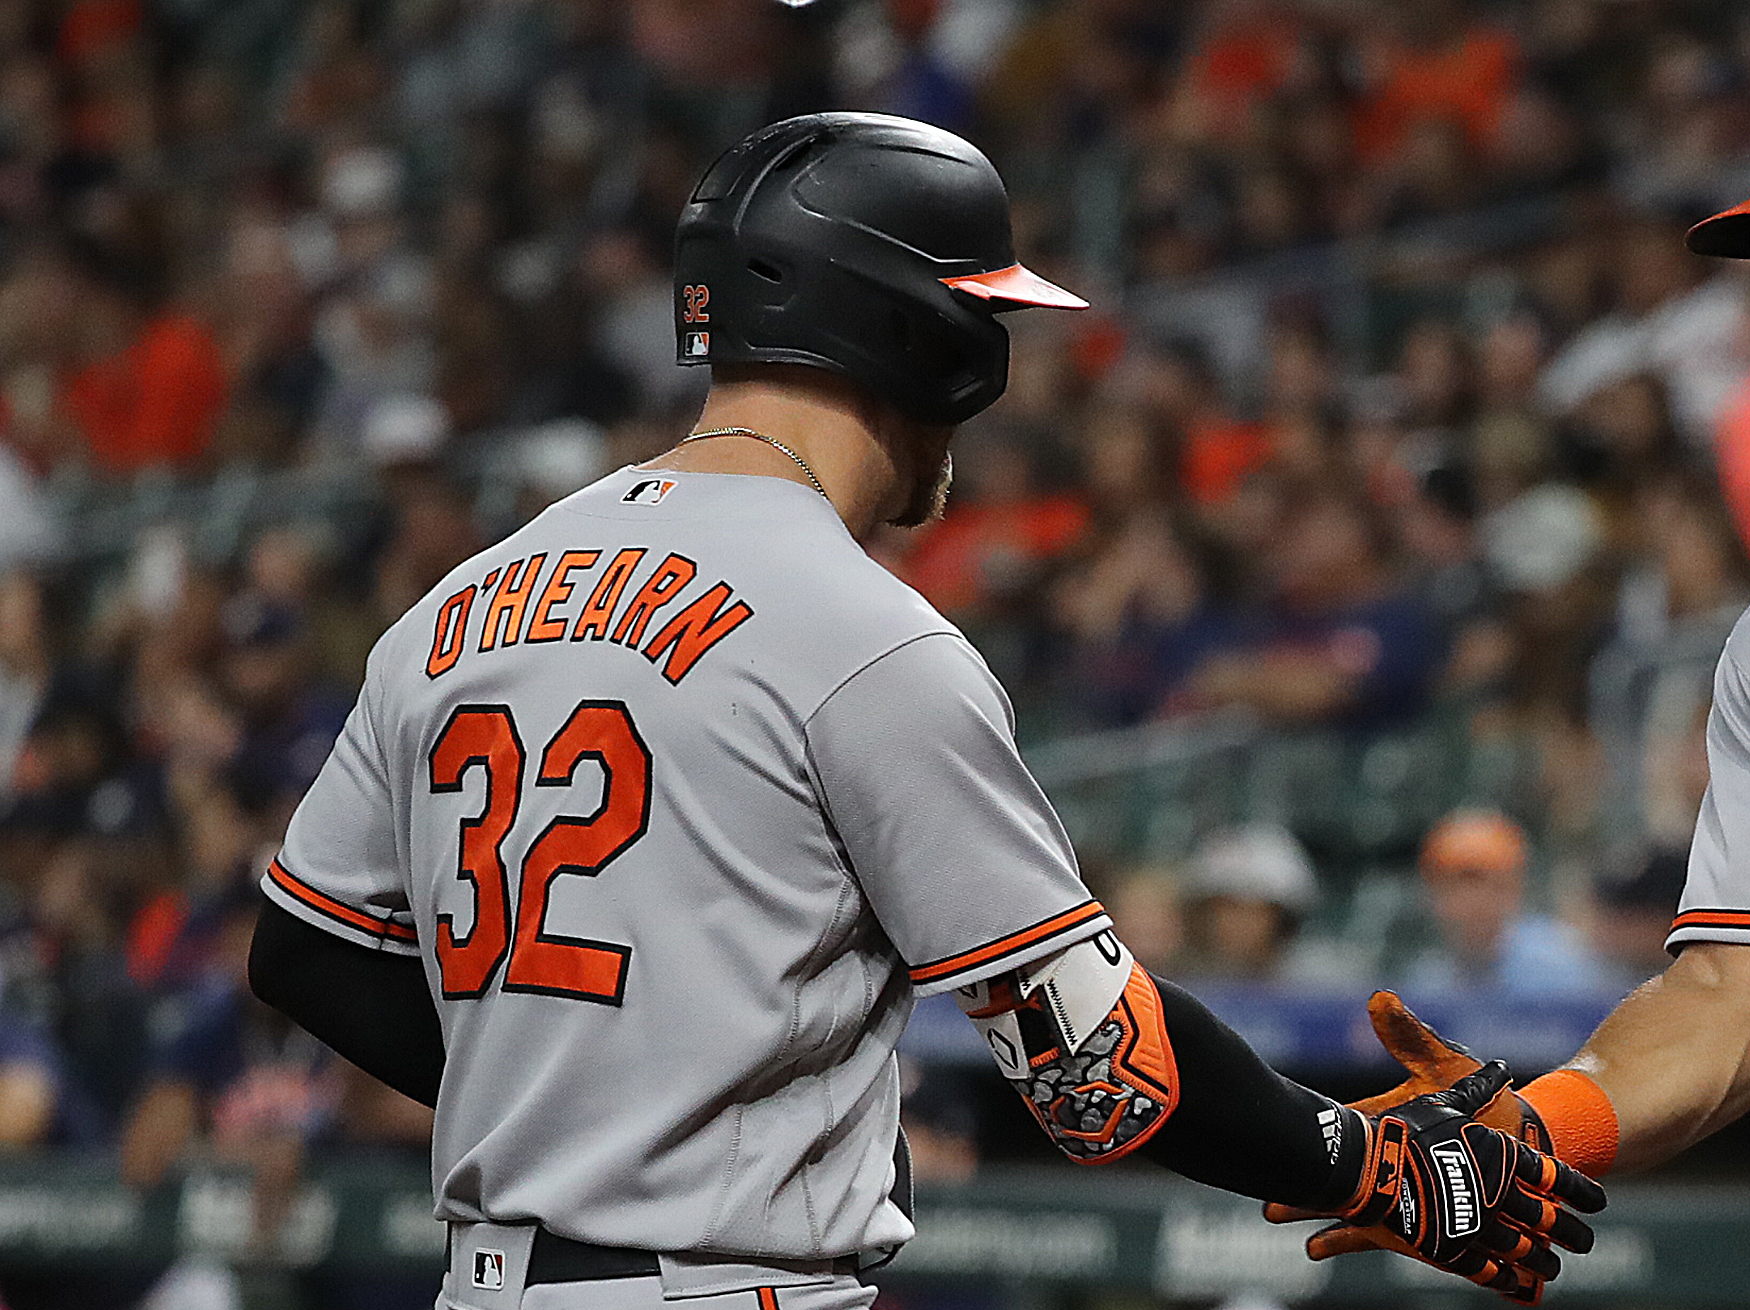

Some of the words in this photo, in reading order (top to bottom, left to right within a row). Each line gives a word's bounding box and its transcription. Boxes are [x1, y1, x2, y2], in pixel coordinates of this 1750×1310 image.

[683, 284, 709, 322] 32
[425, 547, 755, 686] O'HEARN
[428, 699, 653, 1007] 32
[1433, 1149, 1474, 1232] Franklin
